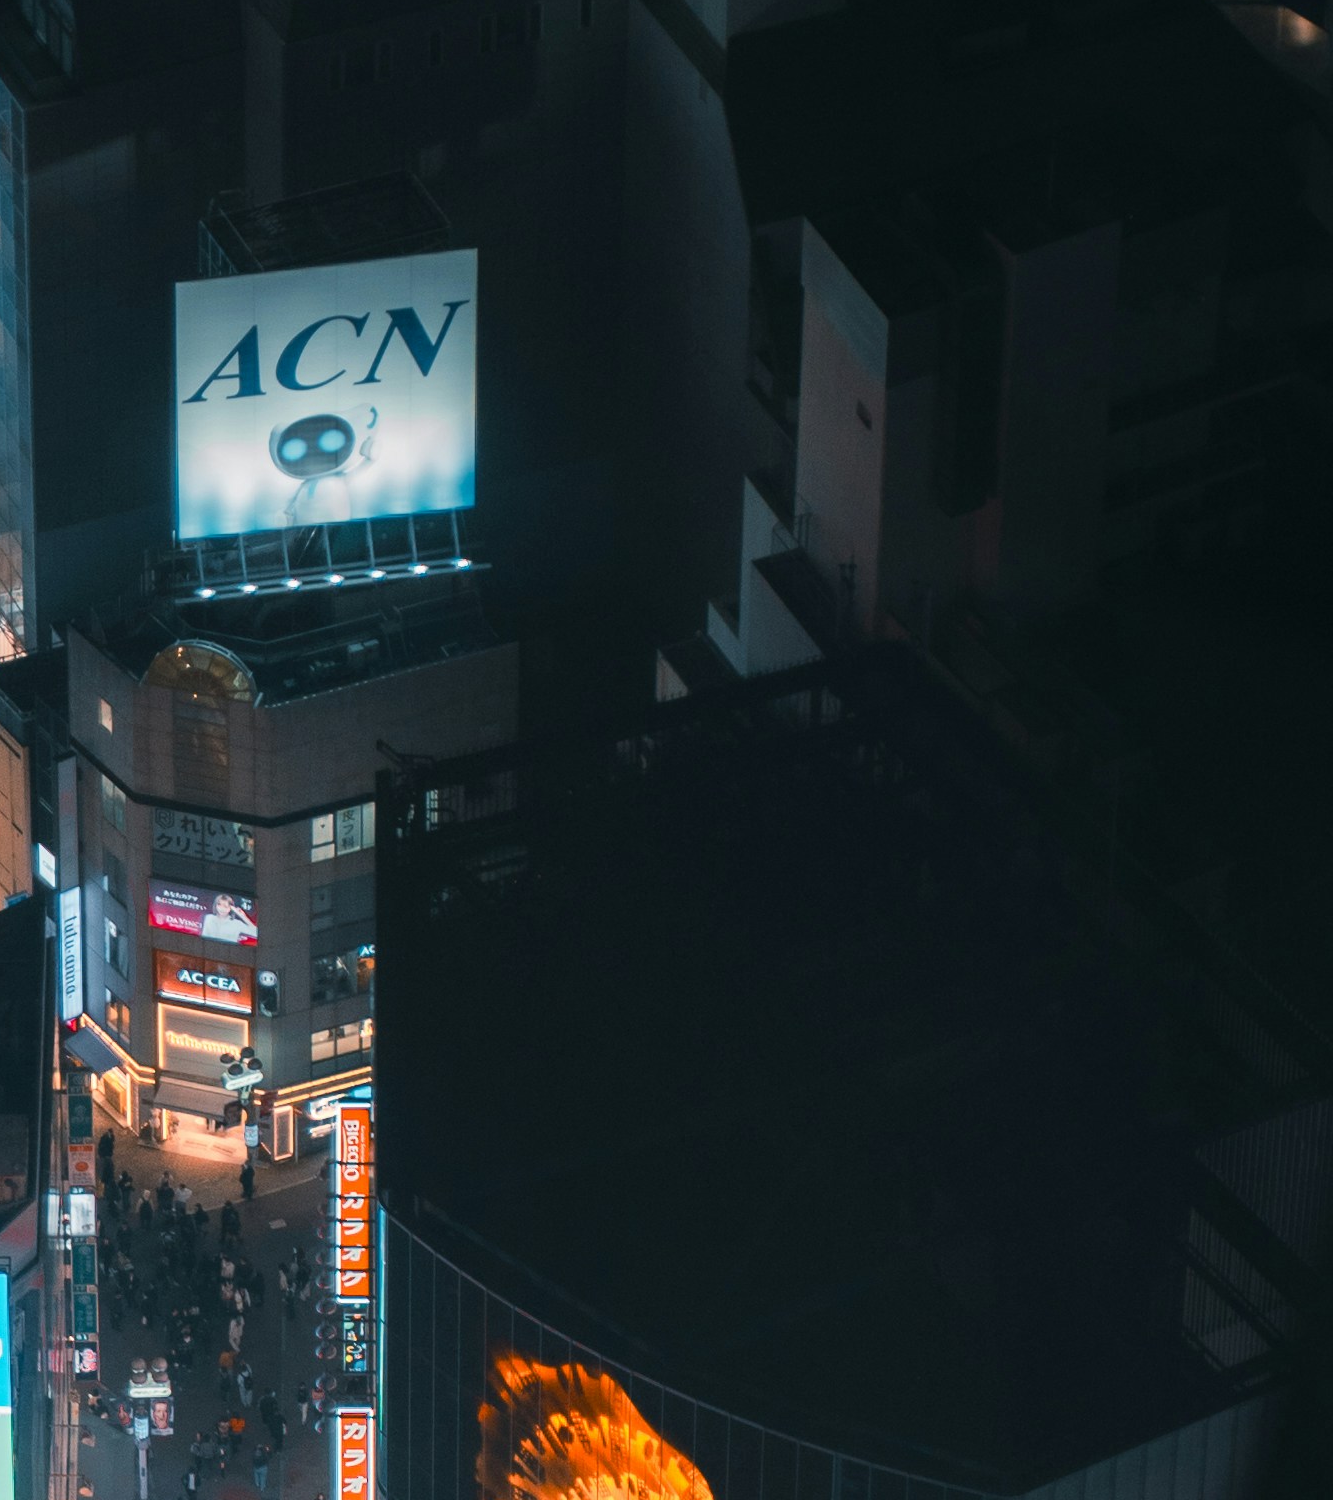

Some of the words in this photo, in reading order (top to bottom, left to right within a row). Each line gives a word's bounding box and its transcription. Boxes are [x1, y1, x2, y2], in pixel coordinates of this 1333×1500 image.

[182, 300, 471, 404] ACN
[156, 832, 253, 864] クリニック
[341, 1191, 366, 1288] カラオケ
